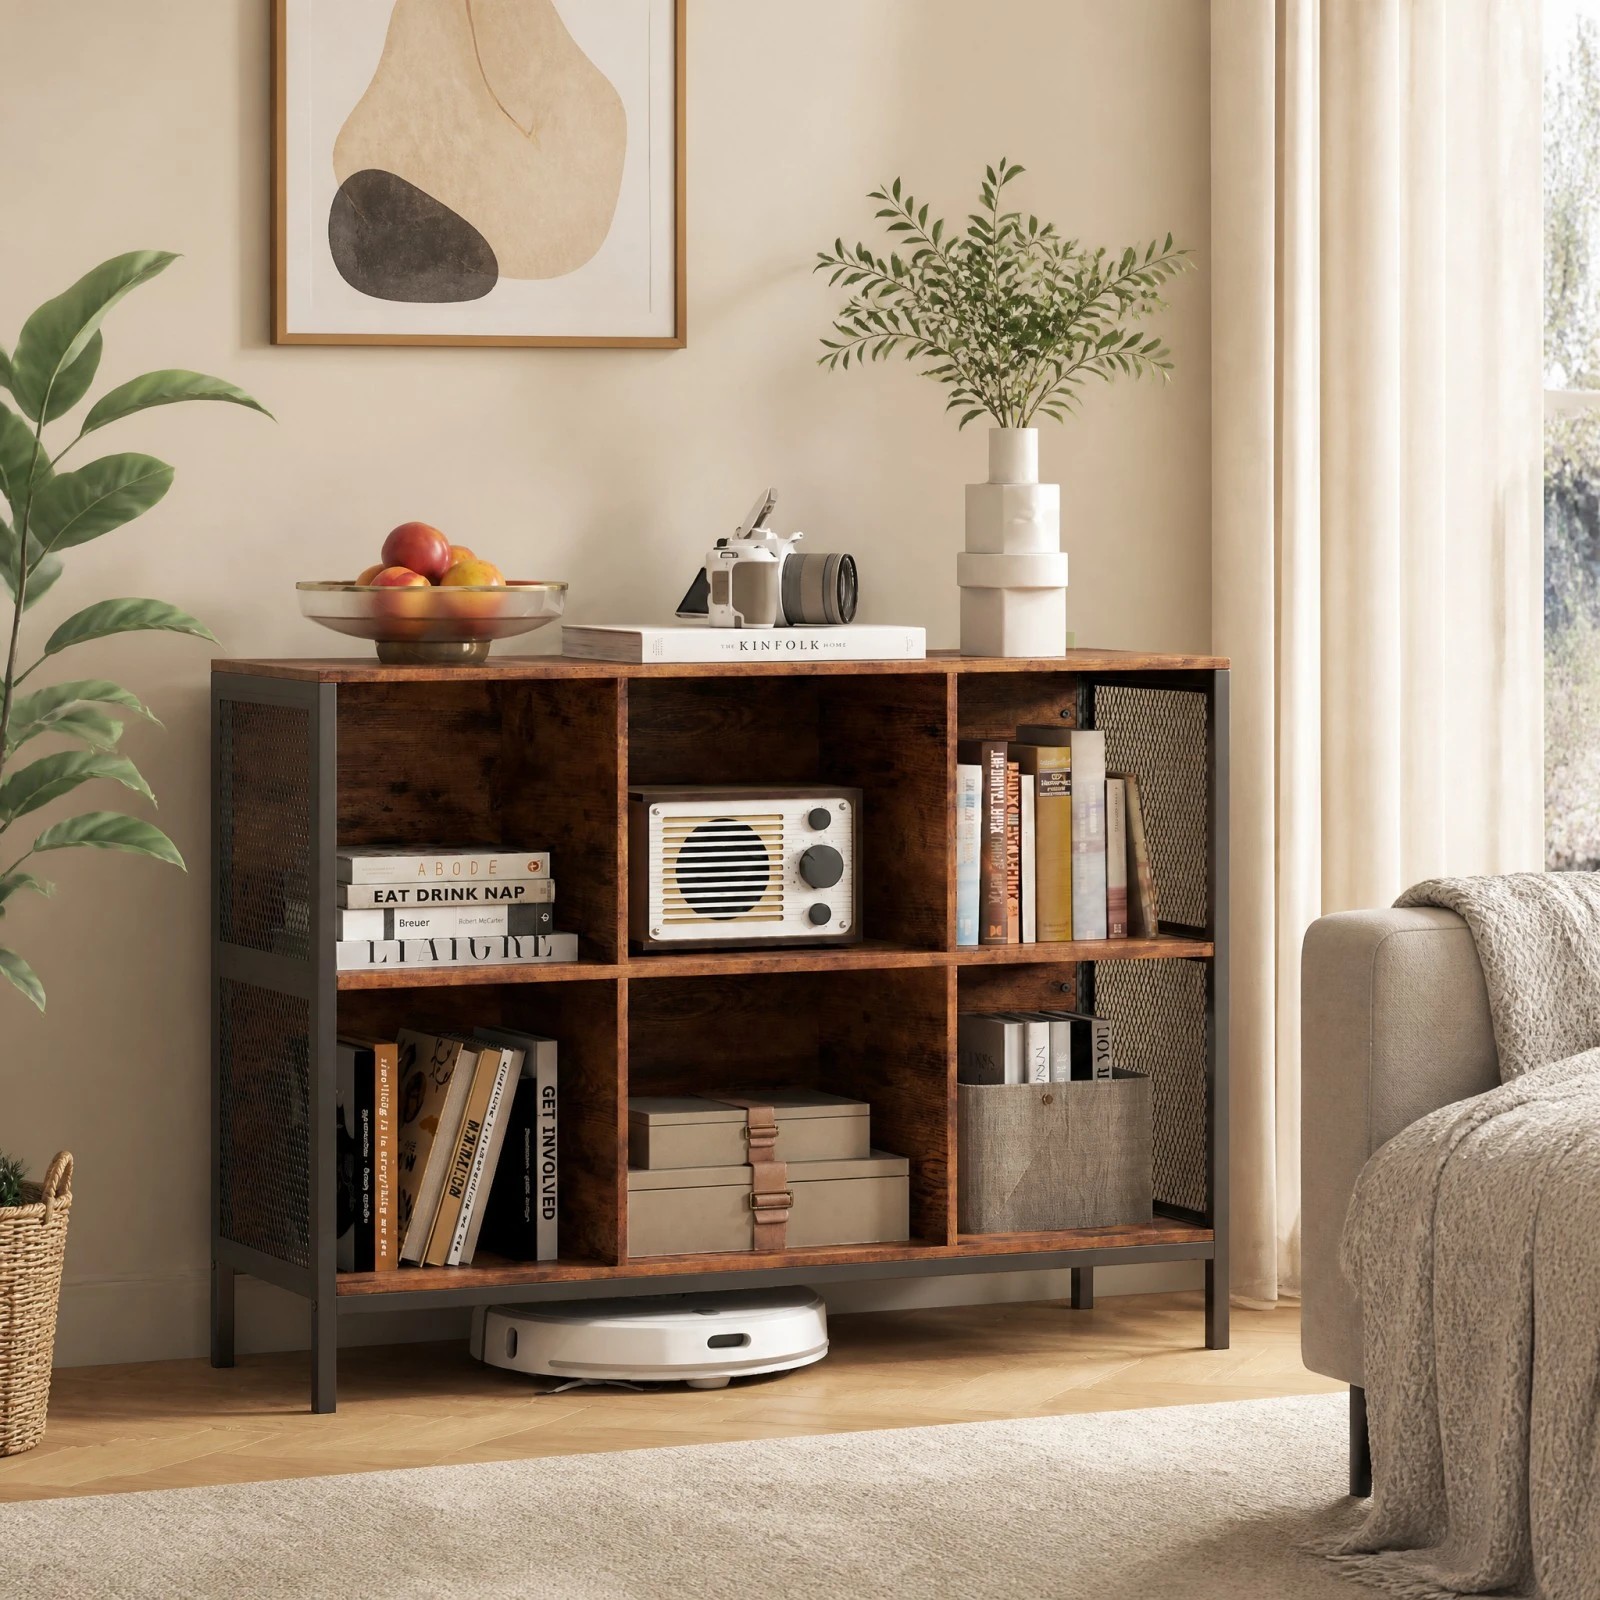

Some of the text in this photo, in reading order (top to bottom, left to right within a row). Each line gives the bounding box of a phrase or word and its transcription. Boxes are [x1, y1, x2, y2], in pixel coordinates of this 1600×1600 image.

[739, 640, 820, 651] KINFOLK
[417, 859, 498, 876] ABODE
[374, 889, 410, 903] EAT
[416, 887, 479, 902] DRINK
[484, 886, 526, 900] NAP
[399, 918, 430, 928] Breuer
[478, 917, 504, 925] McCarter
[541, 1085, 556, 1221] GET INVOLVED
